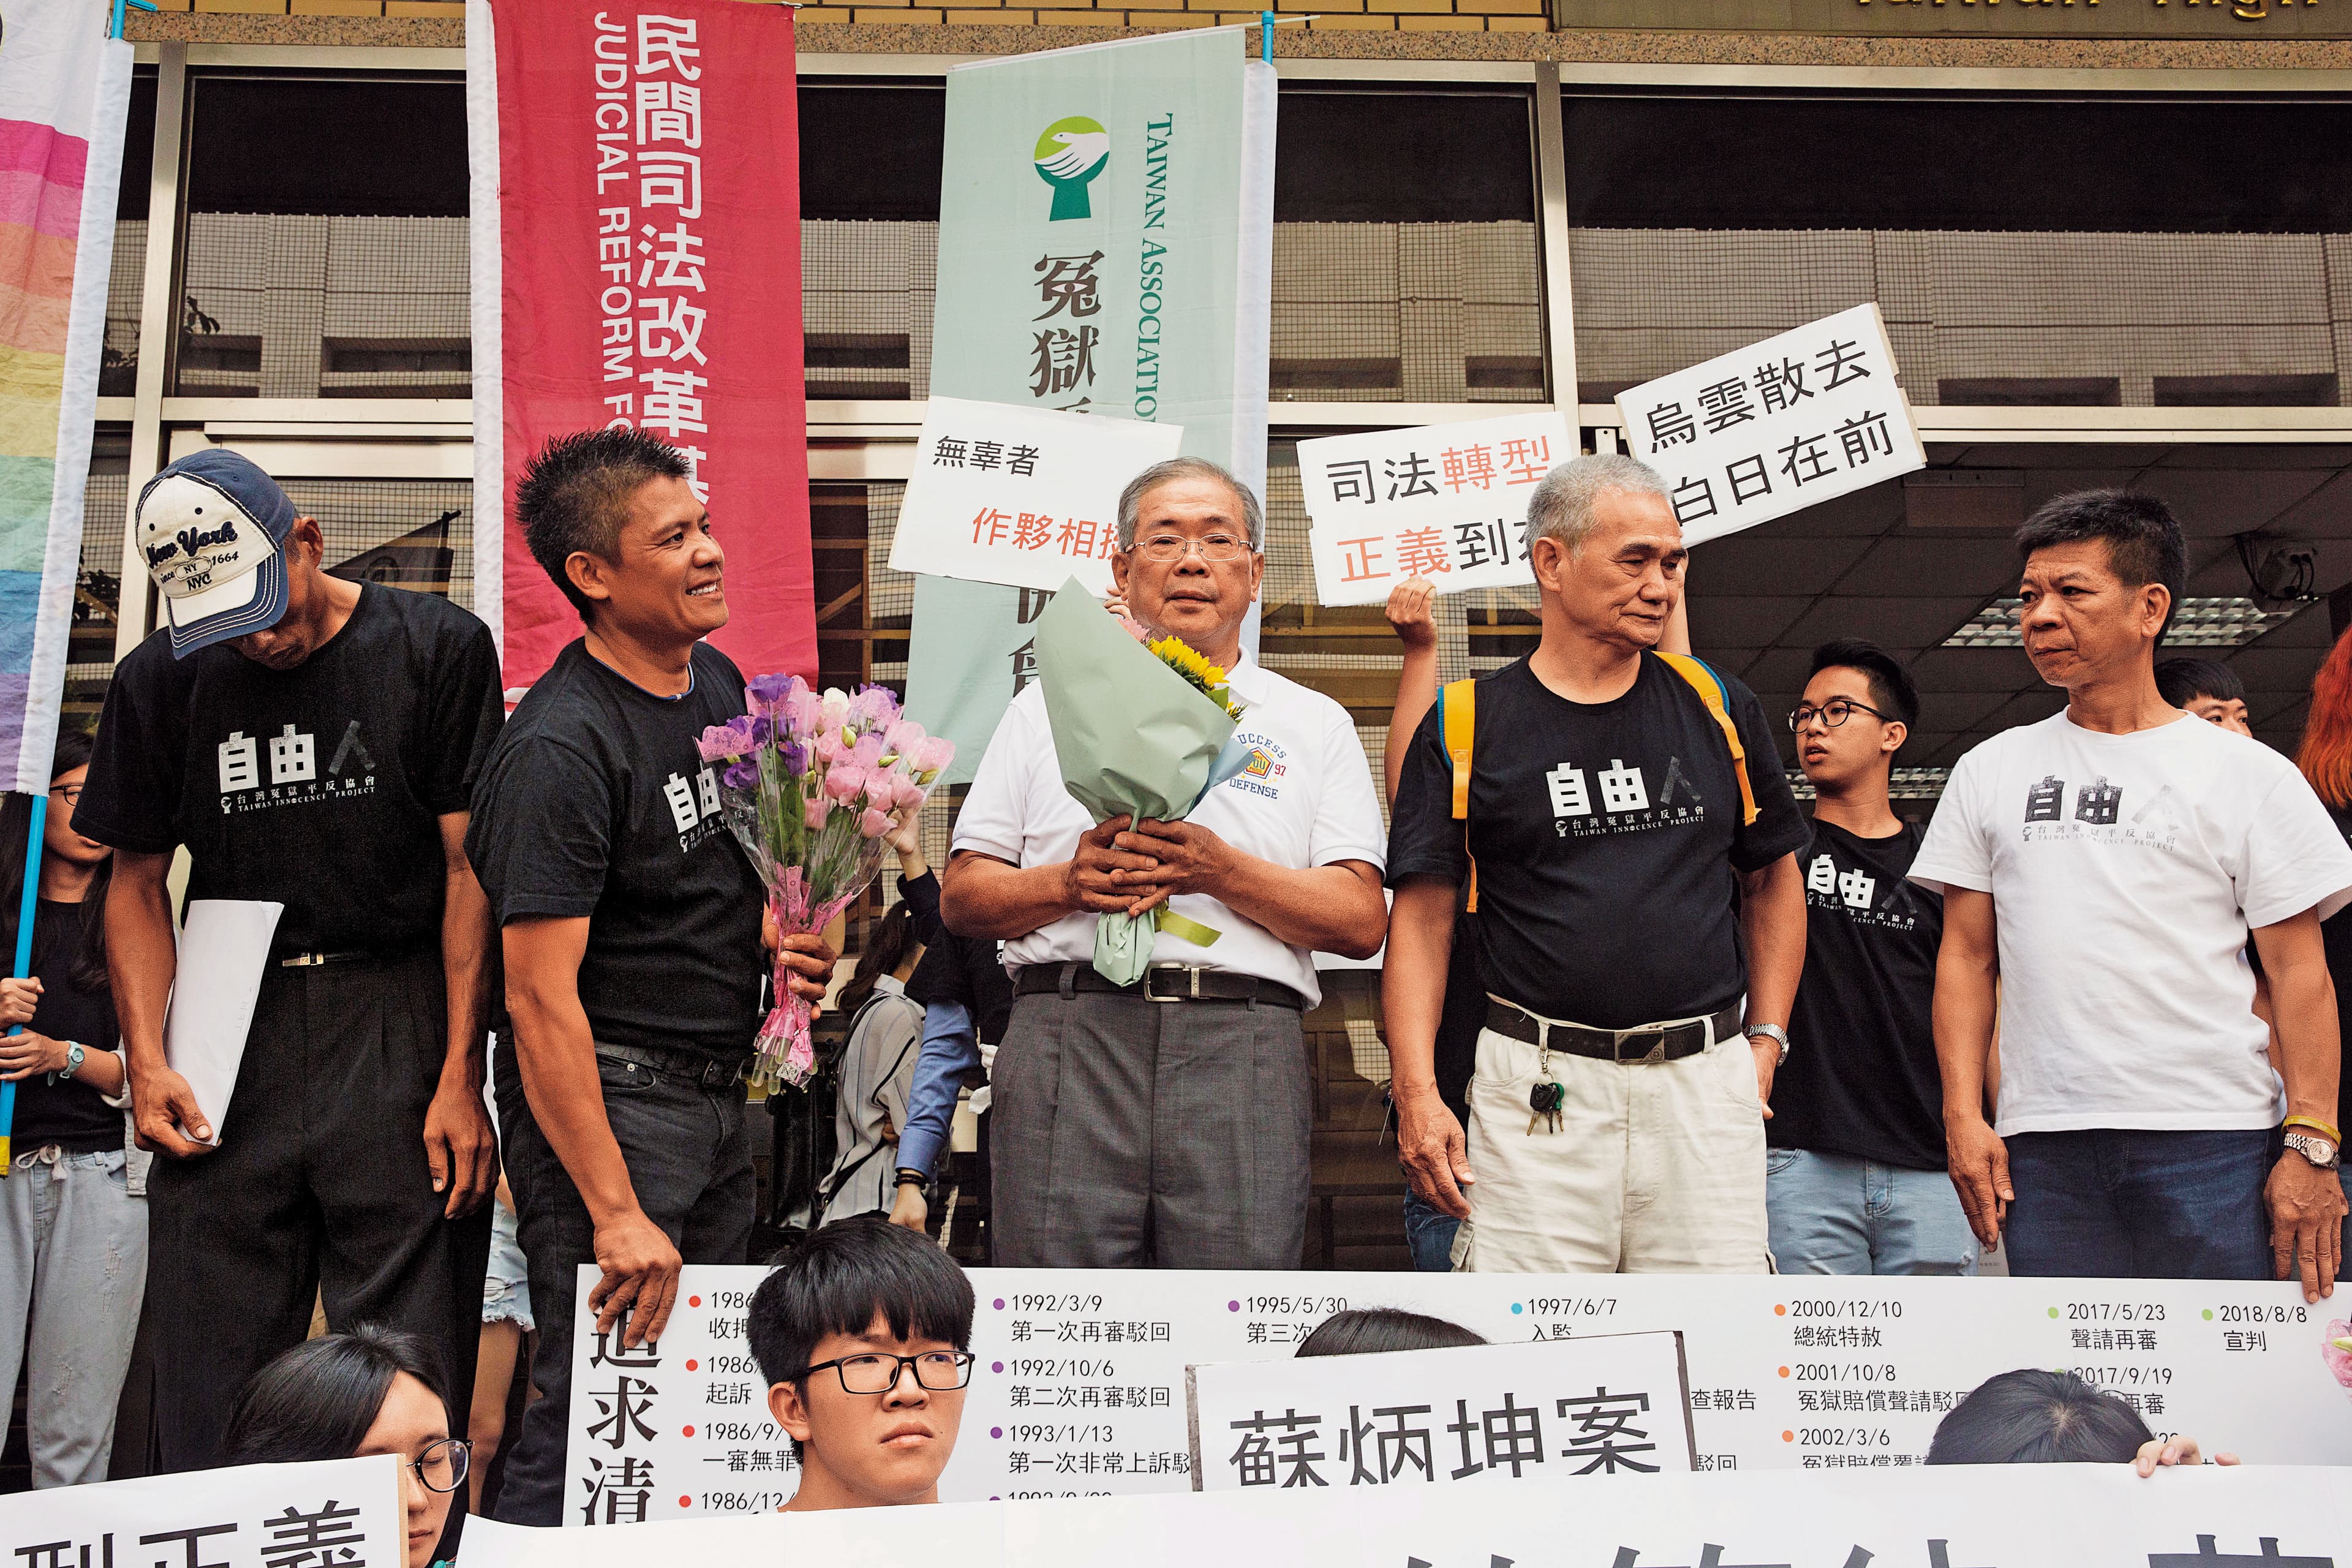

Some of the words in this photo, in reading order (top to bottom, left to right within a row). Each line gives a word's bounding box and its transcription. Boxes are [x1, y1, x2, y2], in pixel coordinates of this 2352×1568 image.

[594, 11, 630, 196] JUDICIAL
[1144, 113, 1174, 230] TAIWAN
[598, 208, 633, 382] REFORM
[1029, 250, 1105, 414] 冤獄
[1134, 237, 1169, 423] ASSOCIATIO
[1648, 338, 1871, 454] 烏雲散去
[932, 435, 1040, 477] 無辜者
[1325, 434, 1551, 505] 司法轉型
[1671, 410, 1893, 527] 白日在前
[146, 541, 179, 569] New
[176, 521, 238, 556] York
[184, 564, 197, 575] NY
[212, 551, 239, 566] 1664
[187, 573, 212, 591] NYC
[1232, 733, 1287, 759] UCCESS
[1275, 764, 1286, 777] 97
[238, 801, 271, 812] TAIWAN
[336, 786, 375, 797] PROJECT
[1229, 778, 1278, 799] DEFENSE
[1572, 805, 1704, 830] 台灣冤獄平反協會
[1574, 827, 1607, 837] TAIWAN
[1670, 815, 1704, 825] PROJECT
[2135, 839, 2175, 851] PROJECT
[1818, 901, 1842, 911] TAIWAN
[1882, 921, 1914, 931] PROJECT
[1012, 1294, 1102, 1313] 1992/3/9
[1246, 1296, 1347, 1314] 1995/5/30
[1528, 1298, 1617, 1316] 1997/6/7
[1792, 1300, 1902, 1318] 2000/12/10
[2068, 1303, 2165, 1322] 2017/5/23
[2220, 1305, 2307, 1323] 2018/8/8
[1011, 1319, 1170, 1343] 第一次再審駁回
[1793, 1325, 1882, 1348] 總統特赦
[2071, 1328, 2158, 1351] 聲請再審
[2223, 1330, 2267, 1352] 宣判
[1010, 1359, 1114, 1378] 1992/10/6
[1796, 1363, 1896, 1382] 2001/10/8
[706, 1382, 752, 1404] 起訴
[1009, 1385, 1170, 1408] 第二次再審駁回
[1691, 1388, 1757, 1411] 查報告
[705, 1422, 783, 1441] 1986/9/
[1009, 1425, 1113, 1444] 1993/1/13
[1229, 1386, 1660, 1488] 蘇炳坤案
[1800, 1428, 1890, 1446] 2002/3/6
[703, 1449, 796, 1472] 一審無罪
[1008, 1450, 1190, 1475] 第一次非常上訴駁
